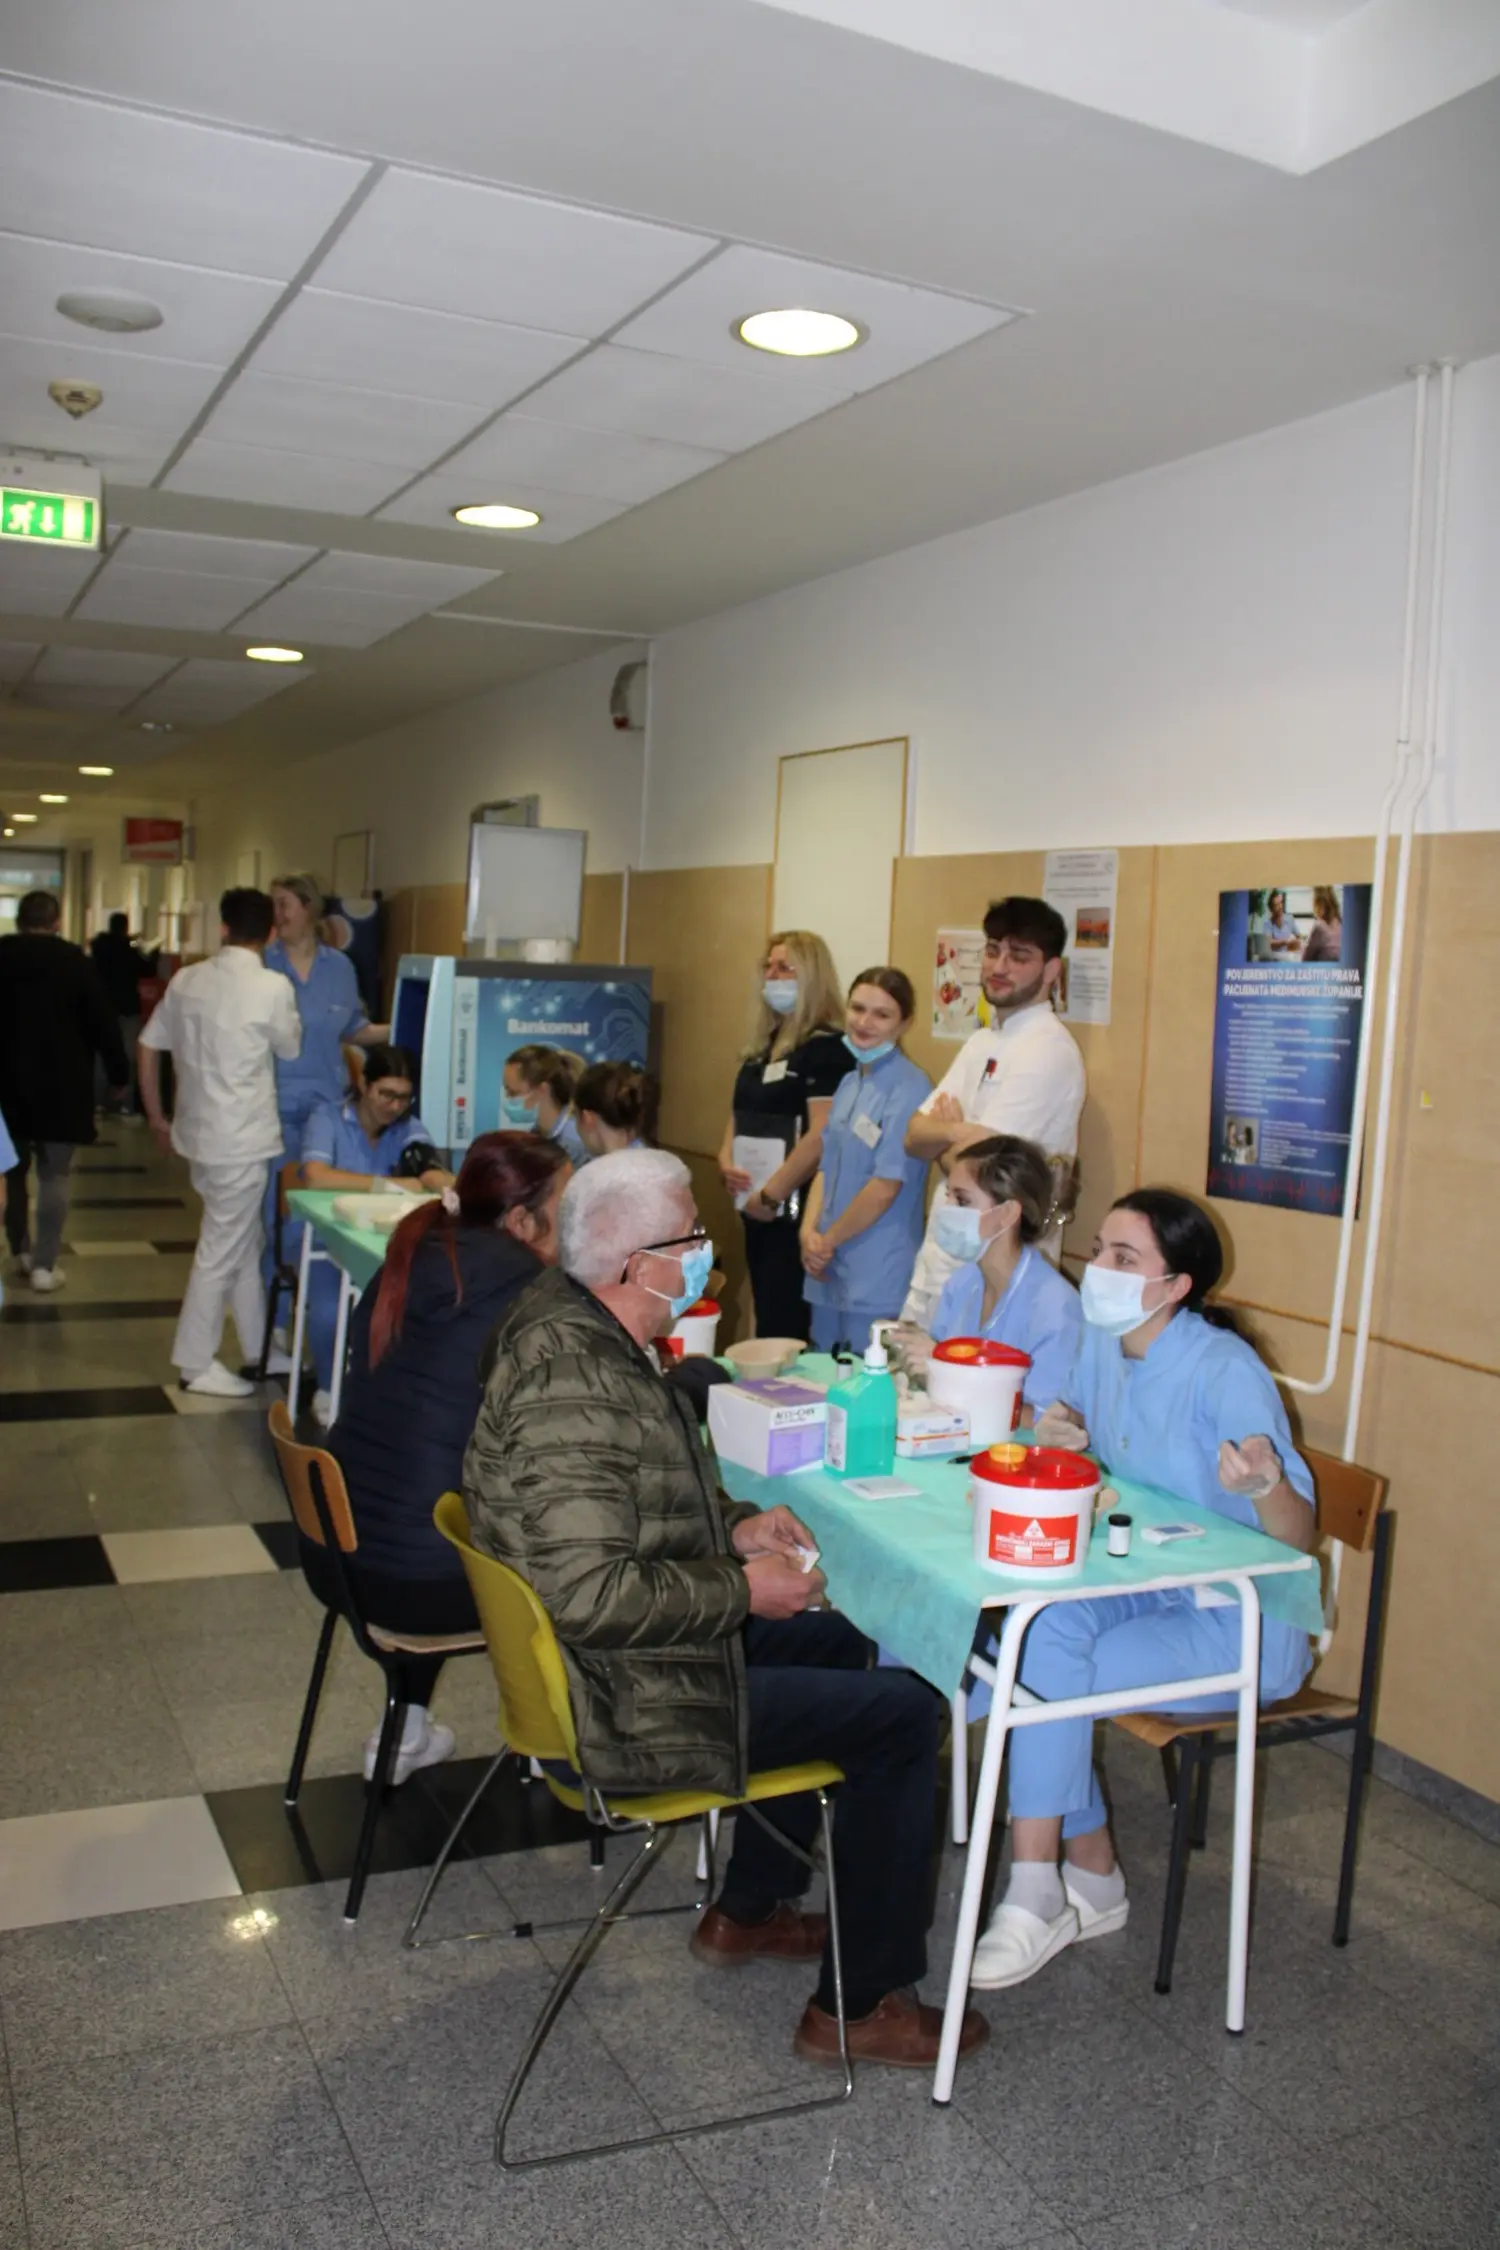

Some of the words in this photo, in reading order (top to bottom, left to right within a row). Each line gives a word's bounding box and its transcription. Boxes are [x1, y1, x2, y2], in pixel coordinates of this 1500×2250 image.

[1285, 968, 1296, 981] ZA
[1331, 968, 1360, 982] PRAVA
[507, 1018, 590, 1036] Bankomat
